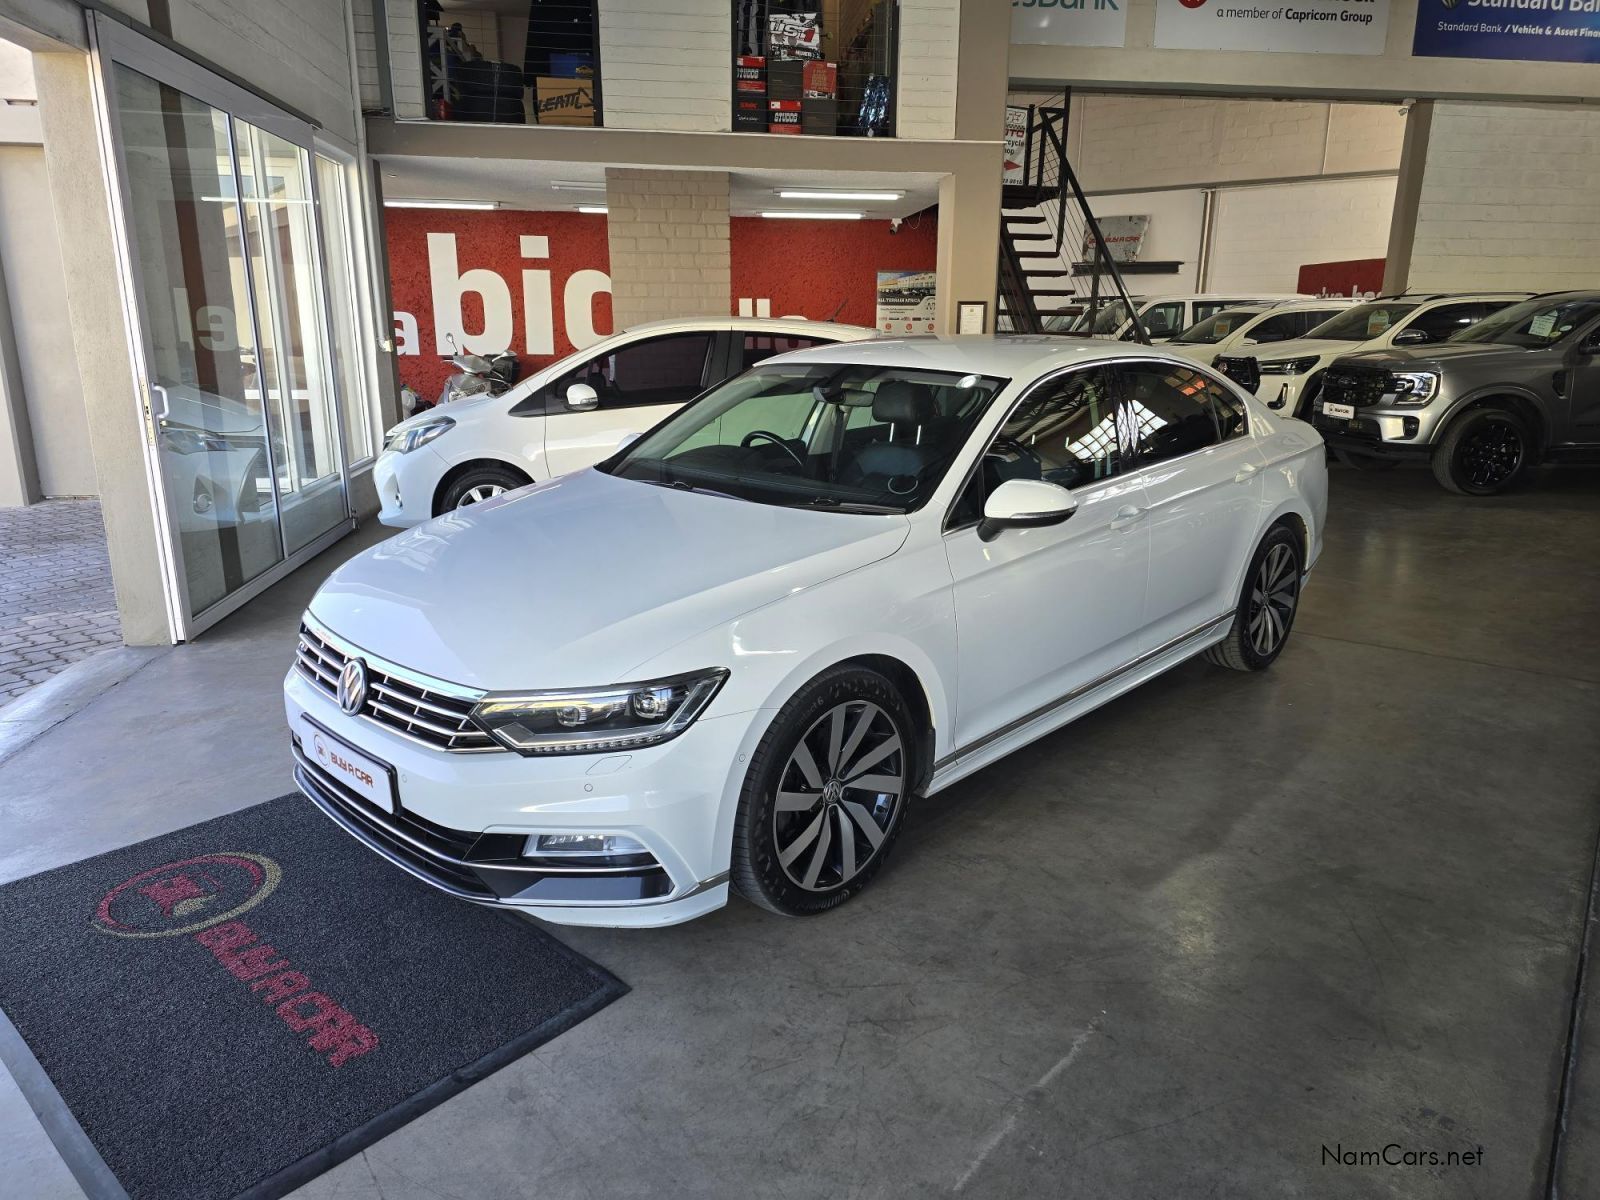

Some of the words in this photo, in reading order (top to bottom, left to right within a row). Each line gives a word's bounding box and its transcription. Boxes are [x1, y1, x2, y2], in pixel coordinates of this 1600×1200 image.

[1217, 9, 1224, 18] a
[1226, 8, 1270, 19] member
[1271, 8, 1284, 19] of
[1285, 8, 1338, 23] Capricorn
[1340, 10, 1373, 25] Group
[1437, 21, 1478, 33] Standard
[1480, 23, 1502, 33] Bank
[1512, 24, 1543, 36] Vehicle
[1545, 26, 1553, 36] &
[1554, 26, 1578, 37] Asset
[330, 751, 348, 772] BUY
[347, 763, 355, 777] A
[355, 767, 374, 789] CAR
[193, 920, 290, 982] BUY
[250, 971, 311, 1004] A
[276, 991, 380, 1068] CAR
